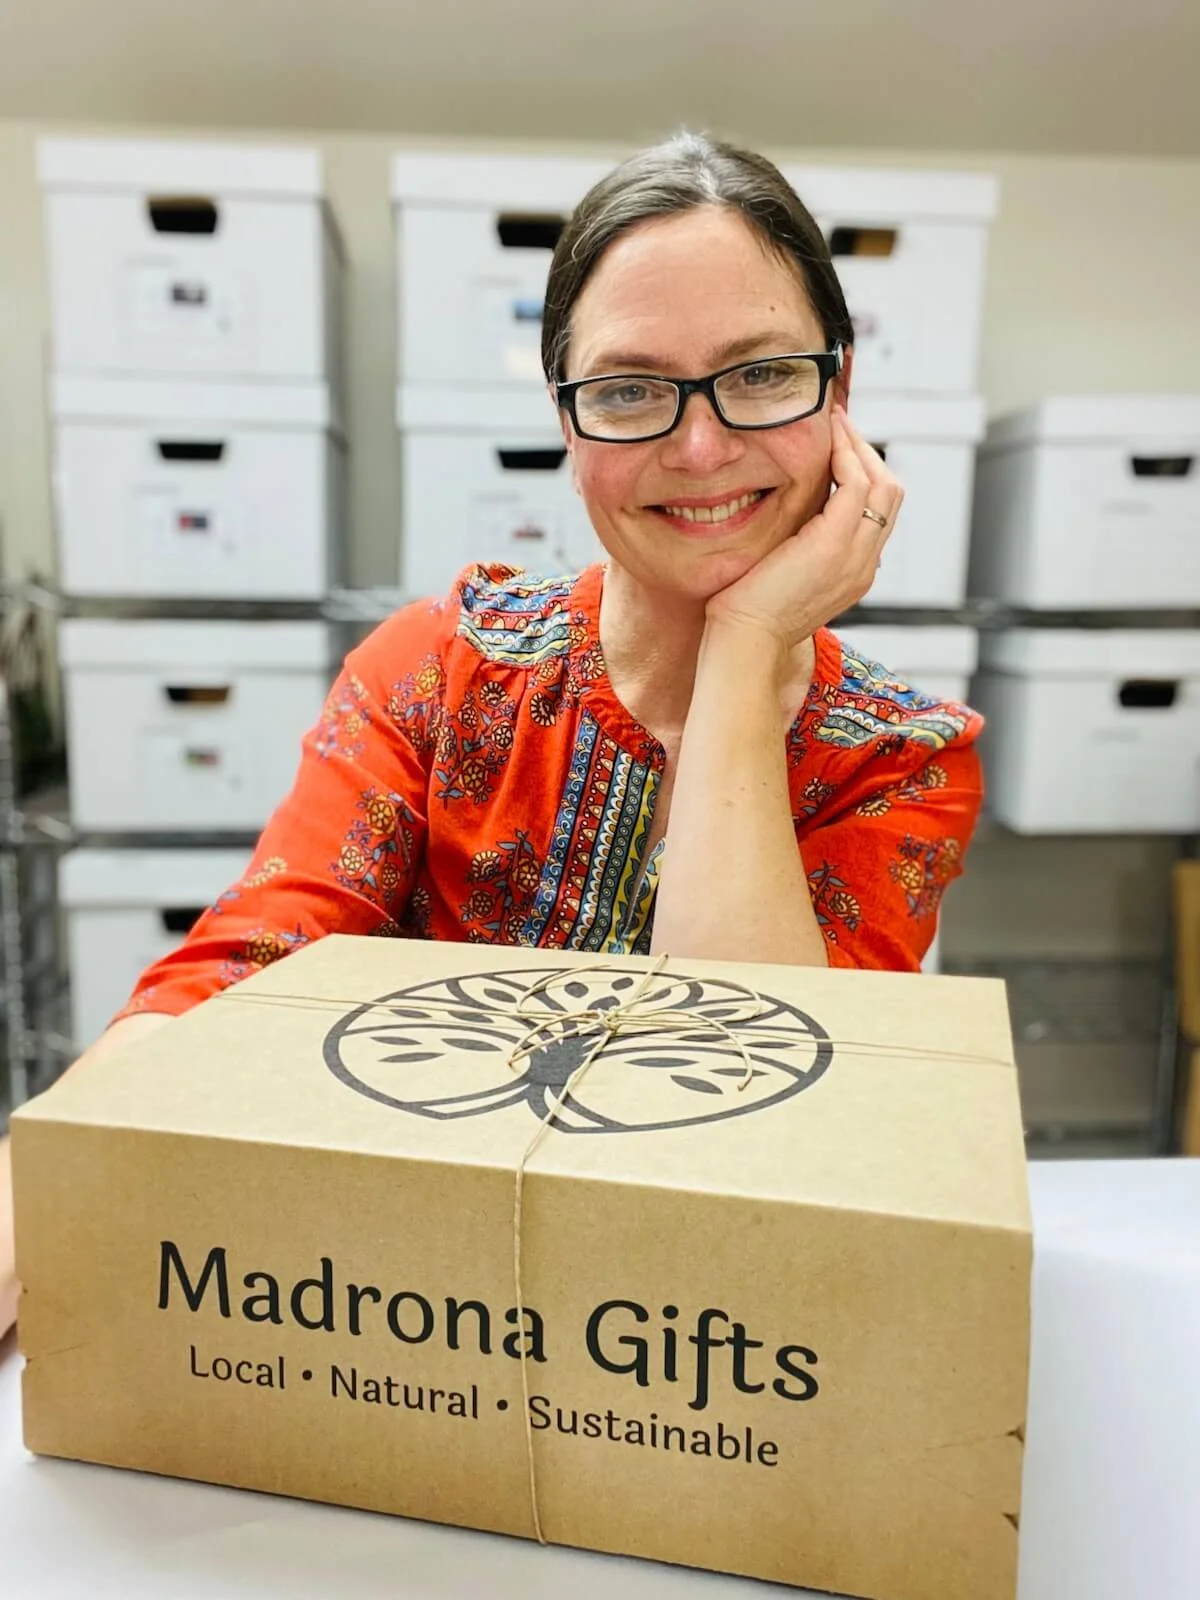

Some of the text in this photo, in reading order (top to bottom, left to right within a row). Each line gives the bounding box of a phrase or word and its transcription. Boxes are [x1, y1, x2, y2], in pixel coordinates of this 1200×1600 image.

[157, 1240, 819, 1411] Madrona Gifts
[189, 1344, 779, 1467] Local Natural Sustainable
